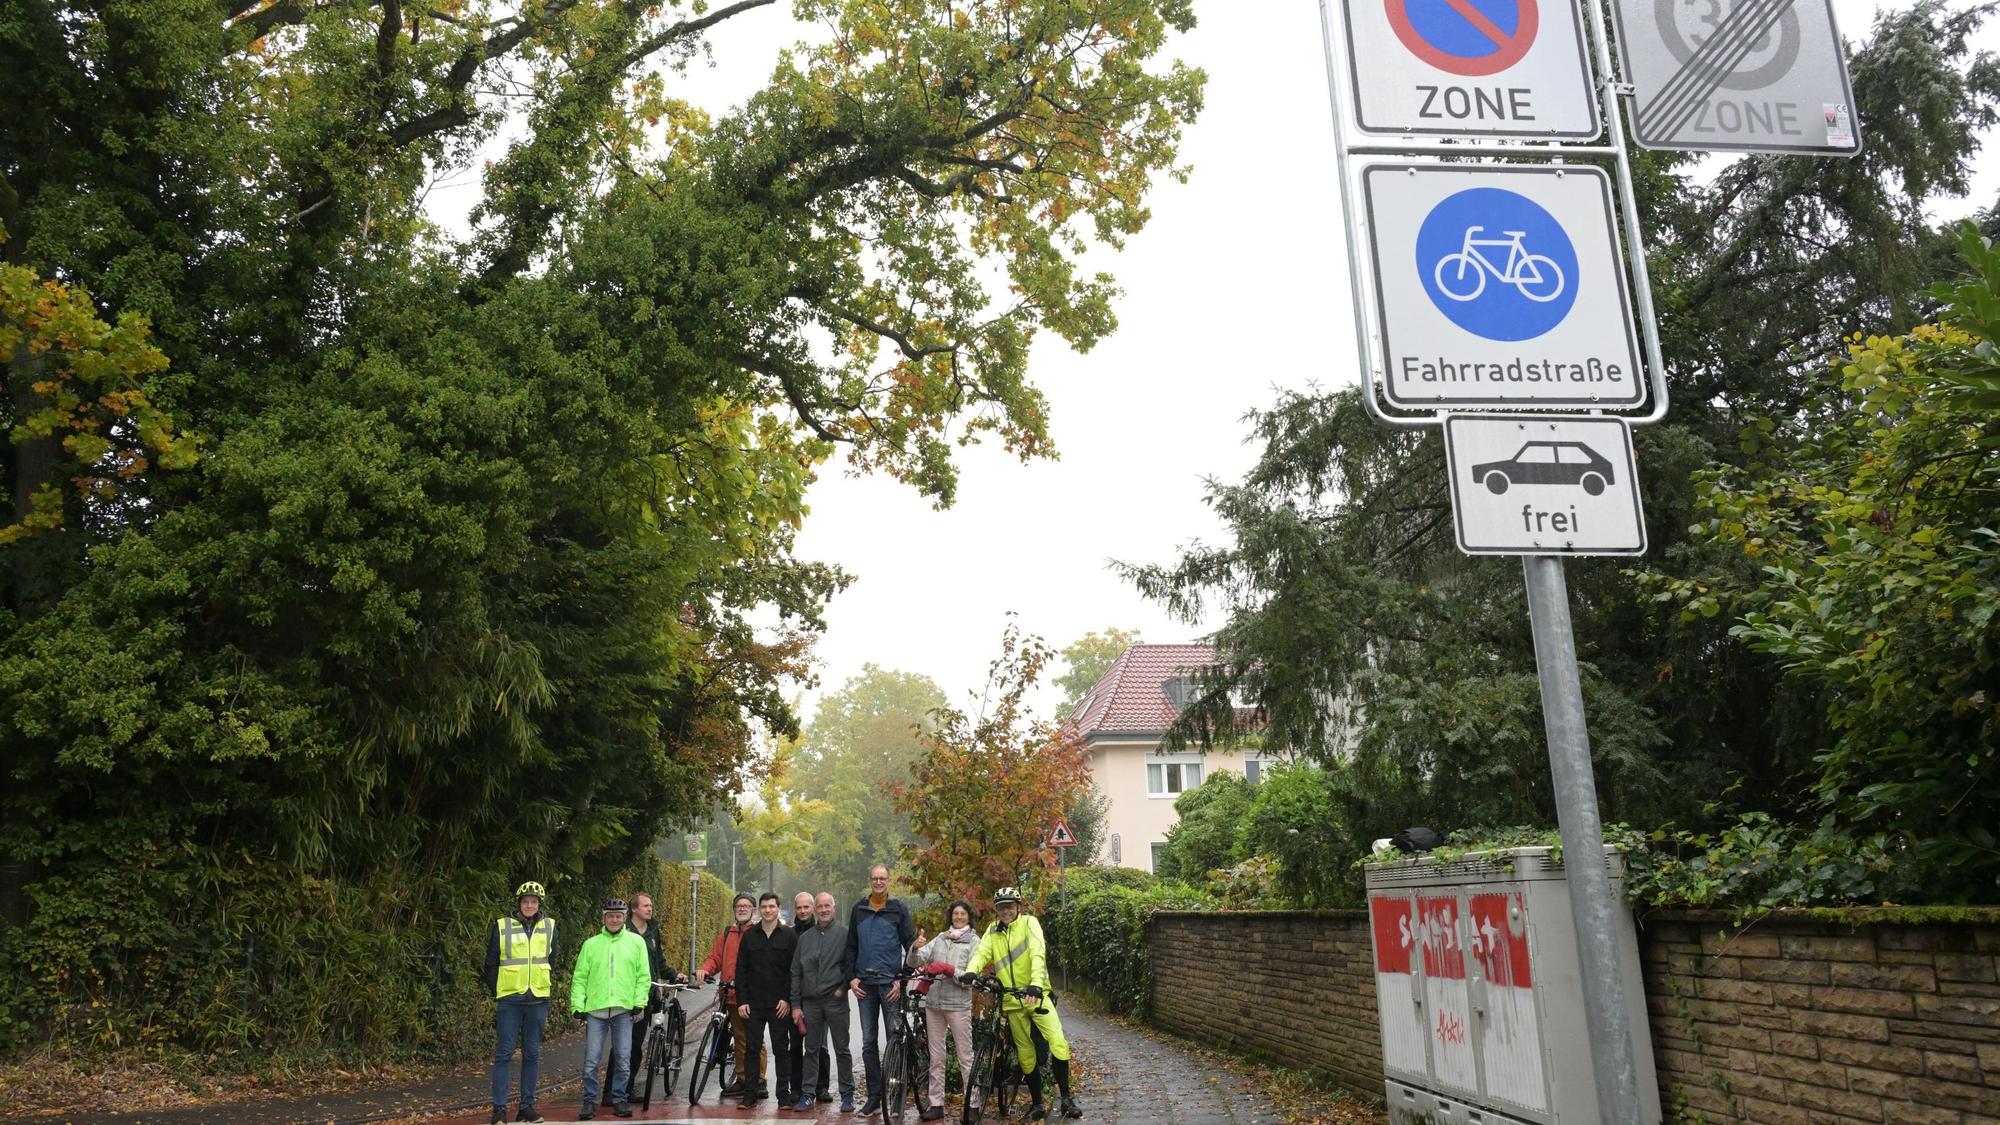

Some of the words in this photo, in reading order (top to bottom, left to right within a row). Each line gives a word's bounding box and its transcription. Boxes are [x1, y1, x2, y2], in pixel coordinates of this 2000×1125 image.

[1415, 85, 1536, 121] ZONE
[1691, 100, 1802, 135] ZONE
[1402, 357, 1622, 382] Fahrradstraße
[1522, 504, 1578, 533] frei
